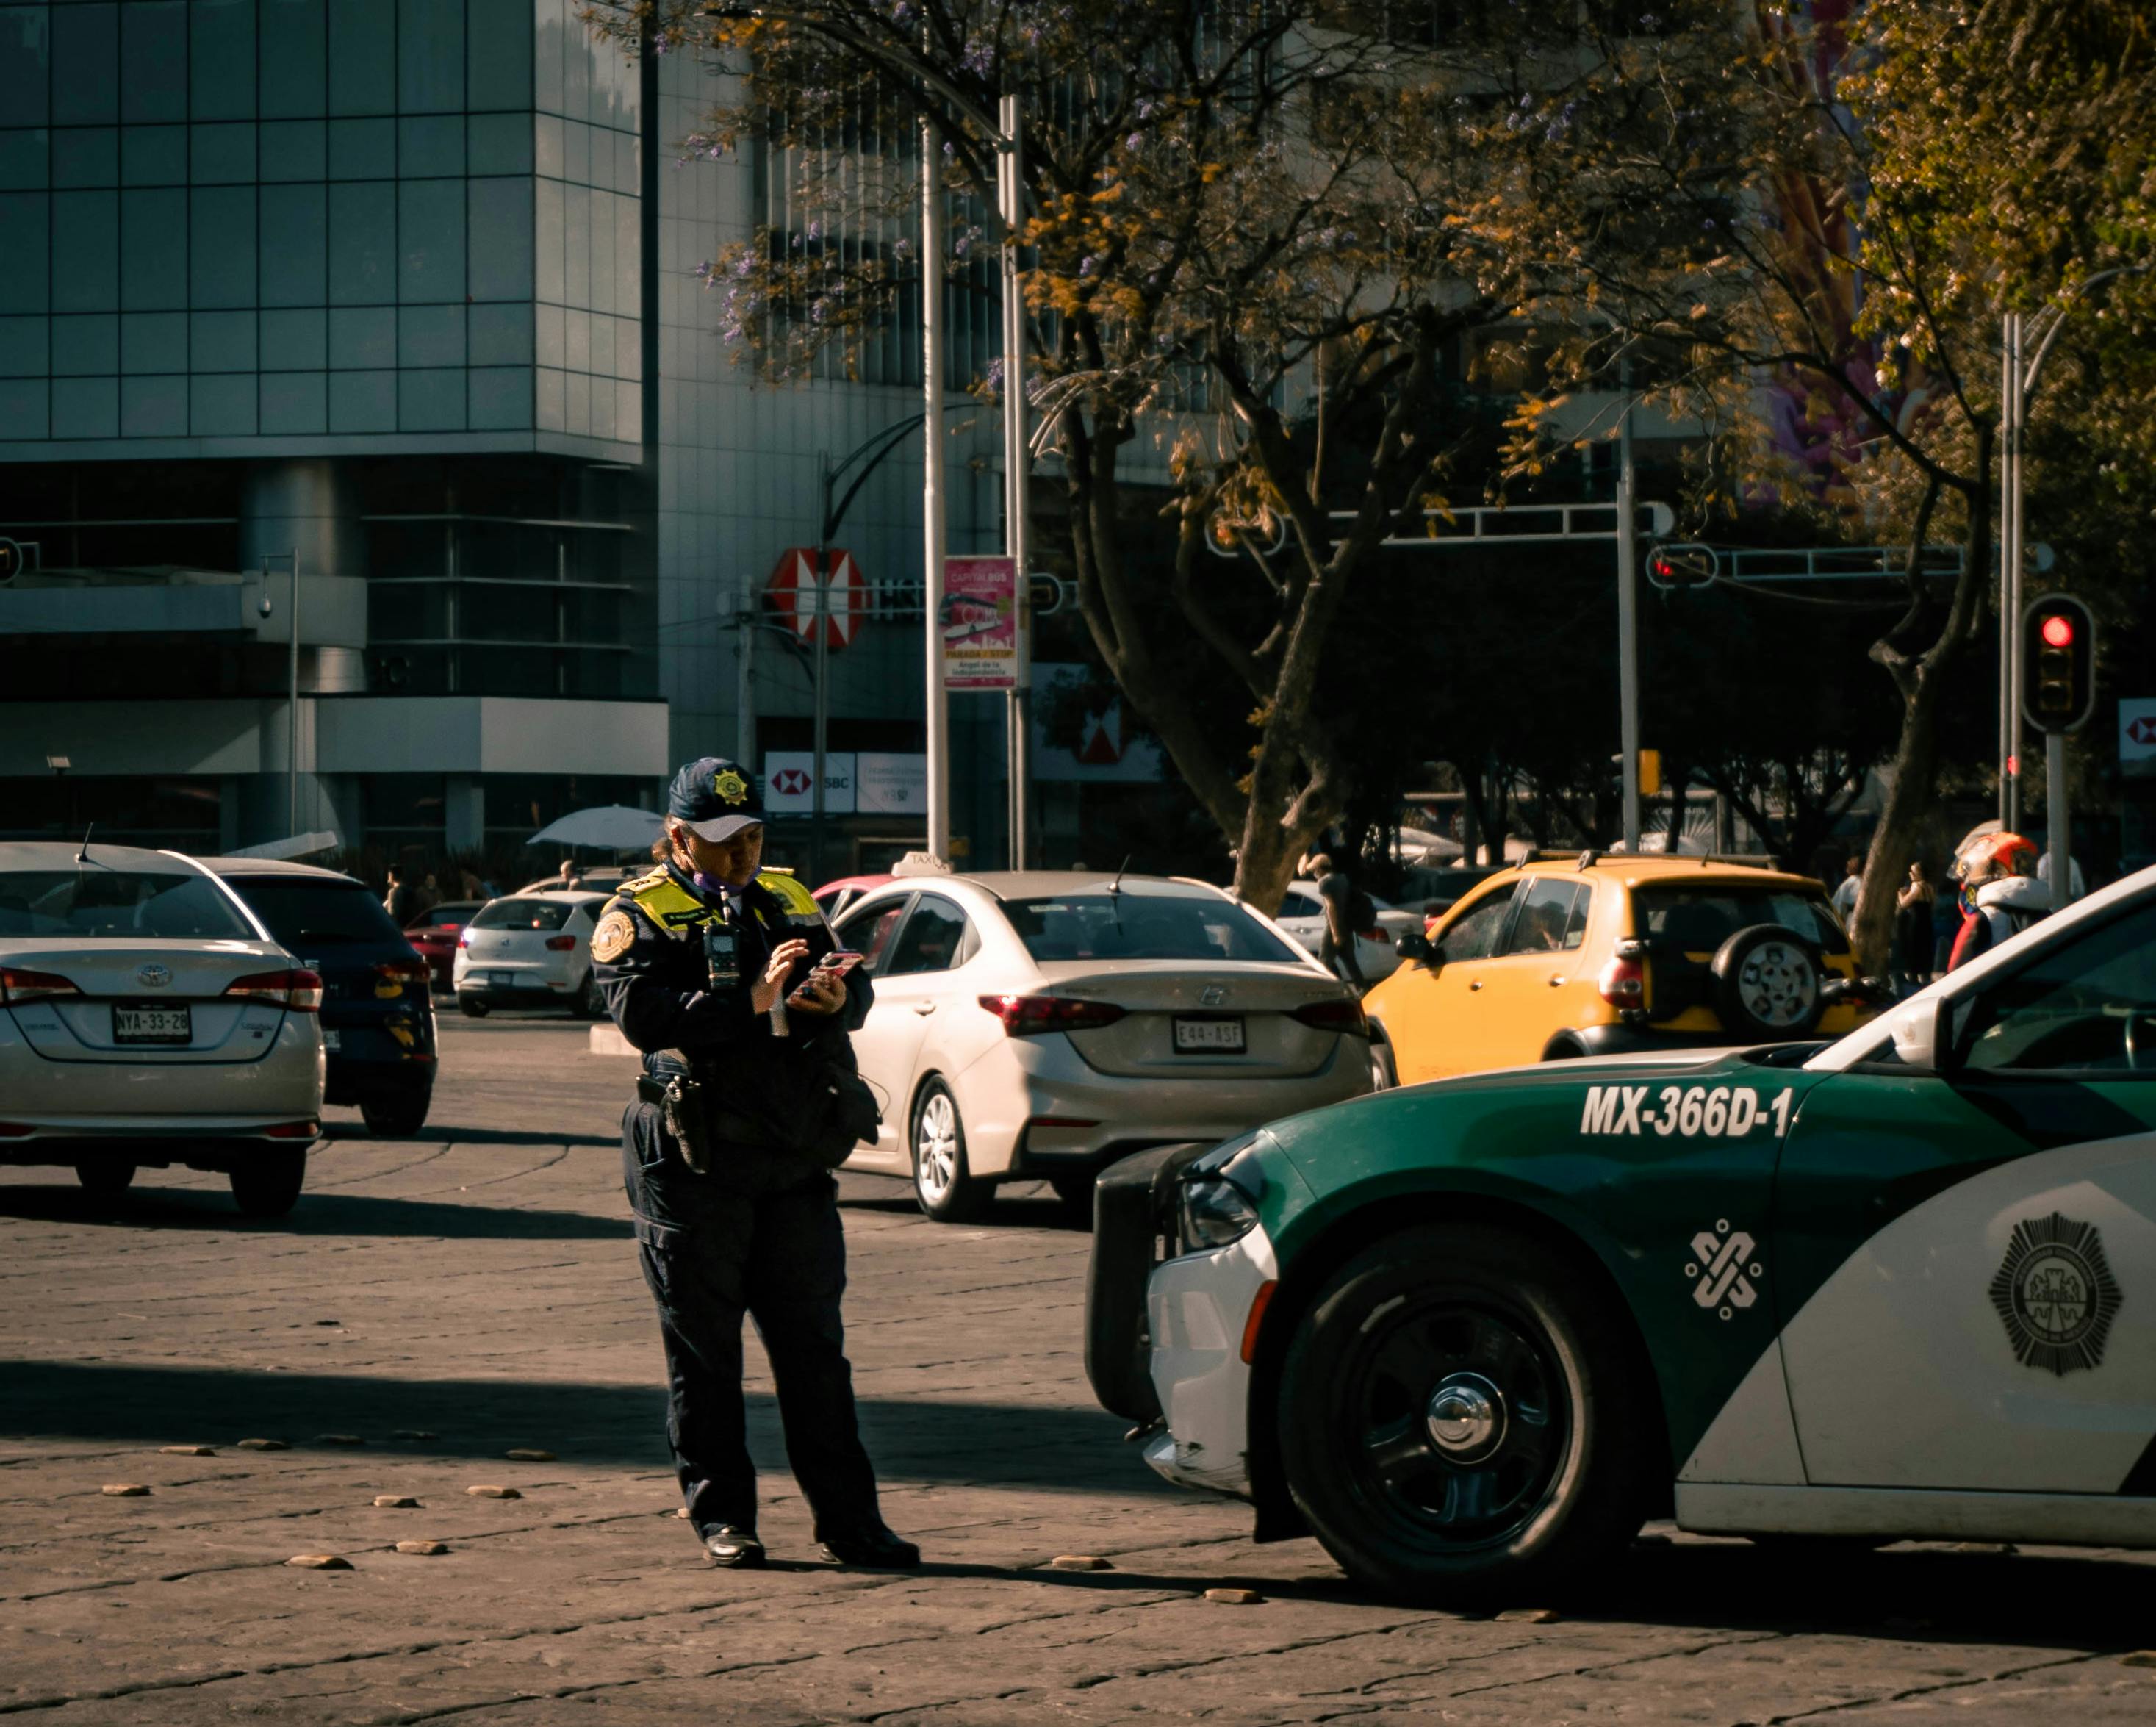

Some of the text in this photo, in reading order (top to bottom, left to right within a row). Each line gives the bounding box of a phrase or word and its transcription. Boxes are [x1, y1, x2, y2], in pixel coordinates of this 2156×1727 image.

[946, 650, 981, 658] PARADA
[990, 650, 1013, 658] STOP
[824, 777, 849, 789] SBC
[910, 855, 935, 864] TAXI
[118, 1013, 189, 1030] NYA-33-28
[1580, 1086, 1793, 1137] MX-366D-1
